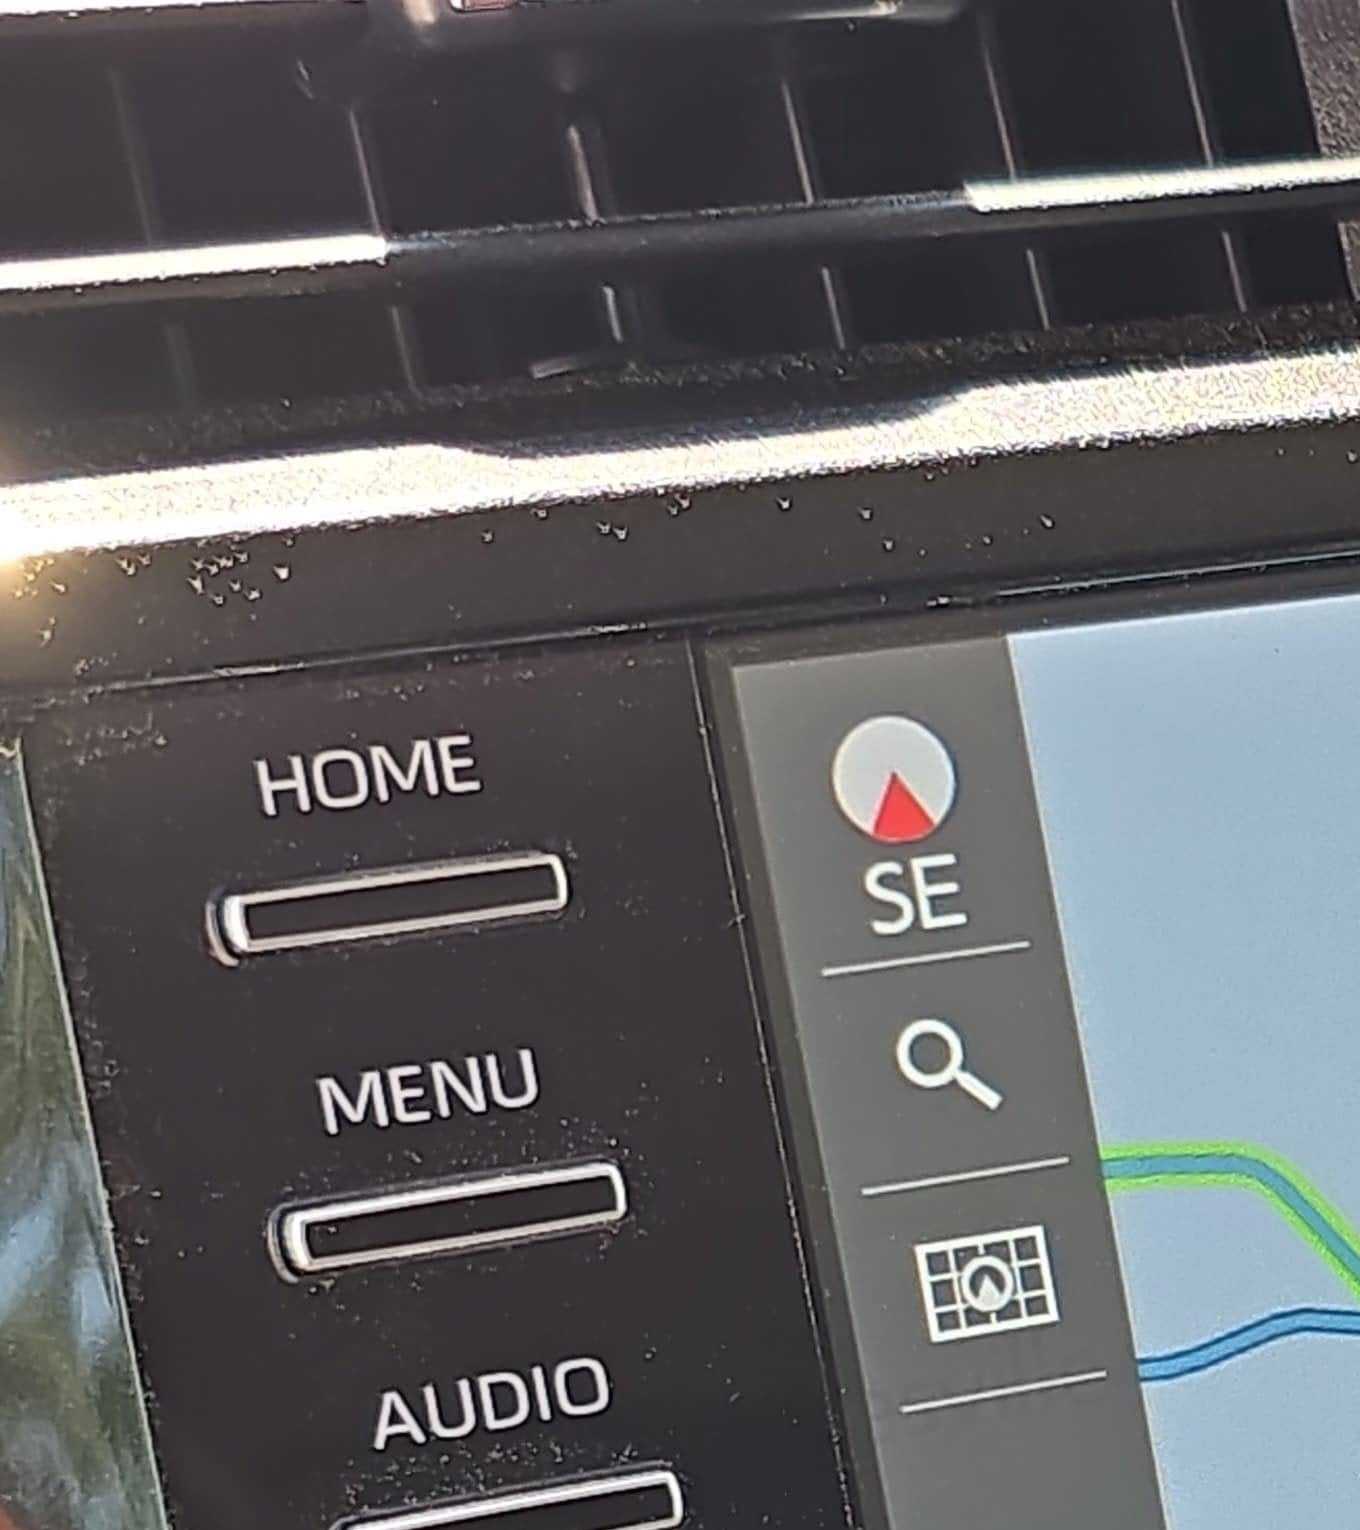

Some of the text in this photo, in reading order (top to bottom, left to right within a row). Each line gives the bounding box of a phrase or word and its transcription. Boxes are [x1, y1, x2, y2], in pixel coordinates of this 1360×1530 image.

[254, 734, 481, 816] HOME
[863, 853, 968, 936] SE
[316, 1049, 540, 1135] MENU
[371, 1356, 611, 1452] AUDIO
